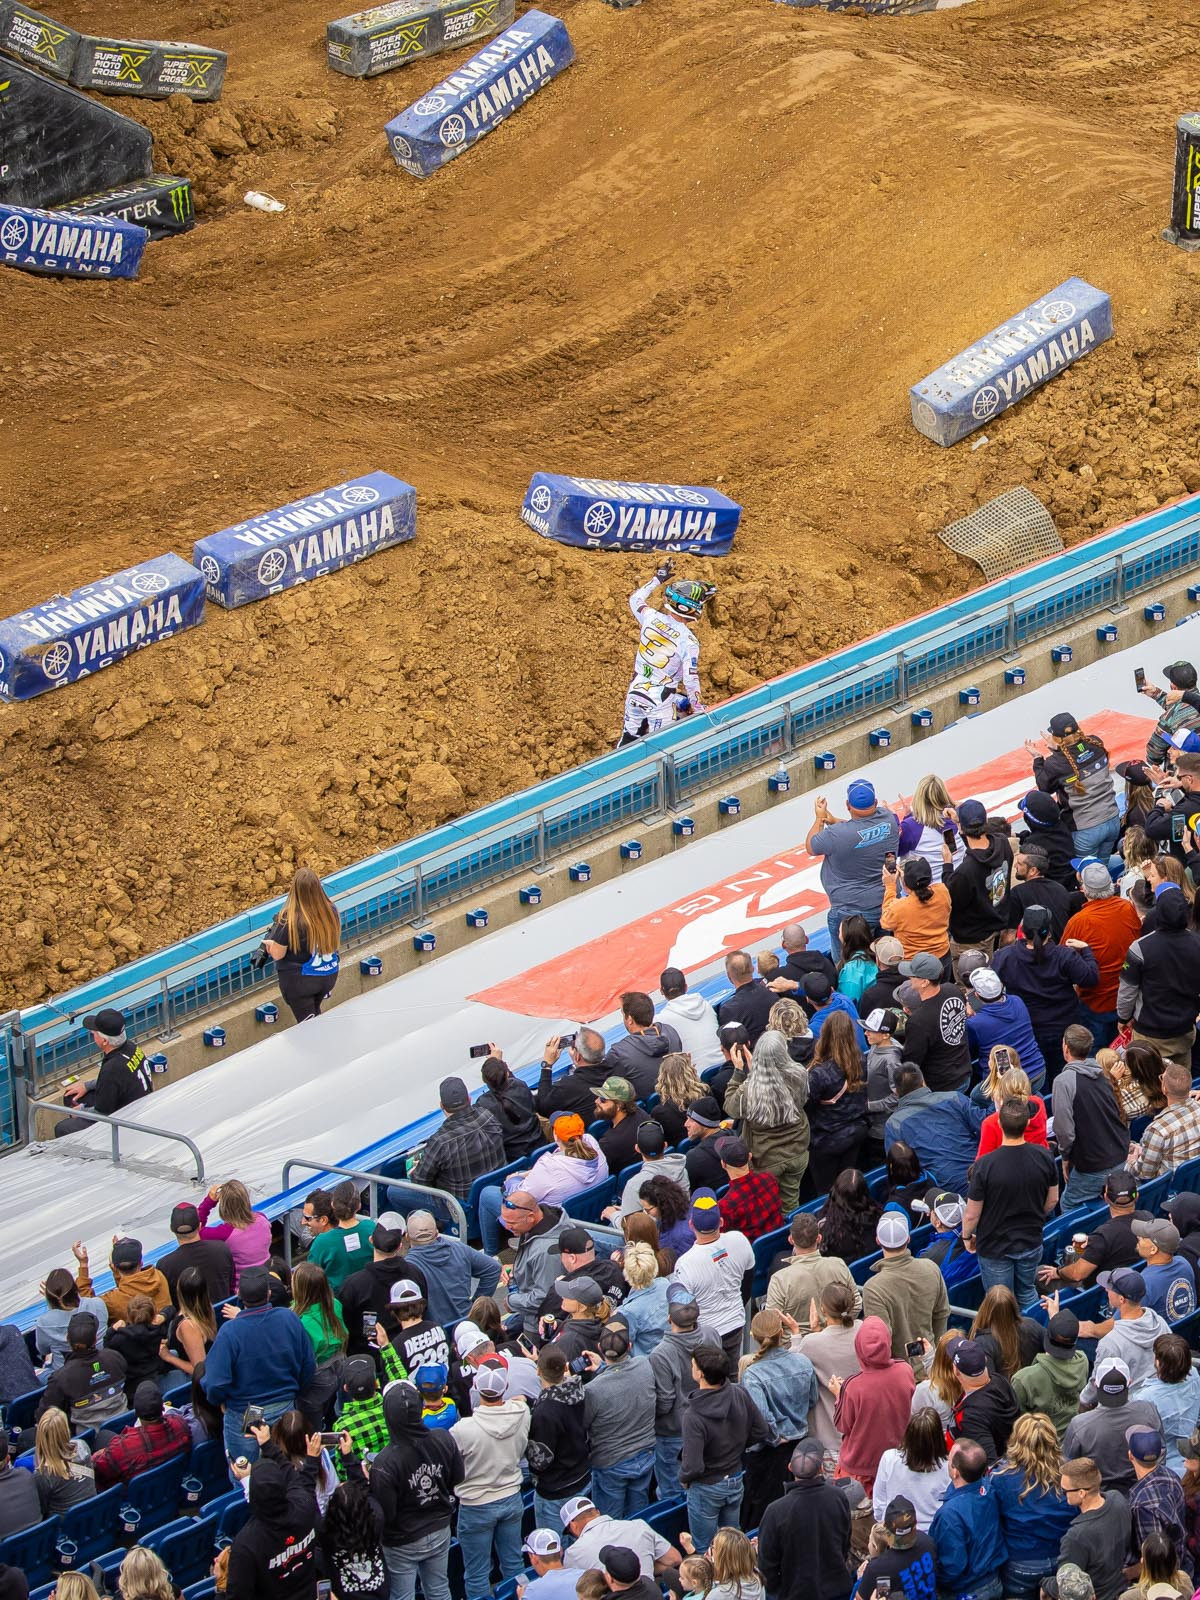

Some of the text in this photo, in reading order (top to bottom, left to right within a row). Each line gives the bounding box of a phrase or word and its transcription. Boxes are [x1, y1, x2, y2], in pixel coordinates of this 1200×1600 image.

[12, 16, 42, 35] SUPER
[444, 12, 475, 27] SUPER
[446, 19, 475, 32] MOTO
[8, 31, 38, 48] CROSS
[12, 24, 40, 42] MOTO
[370, 34, 401, 50] SUPER
[94, 52, 123, 63] SUPER
[371, 48, 401, 63] CROSS
[372, 42, 400, 56] MOTO
[92, 67, 120, 77] CROSS
[95, 61, 121, 70] MOTO
[162, 67, 188, 76] MOTO
[163, 60, 190, 70] SUPER
[435, 29, 533, 97] YAMAHA
[158, 75, 186, 84] CROSS
[462, 45, 555, 129] YAMAHA
[30, 221, 123, 264] YAMAHA
[5, 252, 112, 274] RACING
[947, 319, 1053, 387] YAMAHA
[995, 318, 1095, 401] YAMAHA
[235, 501, 358, 547] YAMAHA
[522, 506, 550, 534] YAMAHA
[616, 506, 717, 542] YAMAHA
[289, 505, 395, 573] YAMAHA
[19, 581, 143, 638] YAMAHA
[74, 594, 182, 665] YAMAHA
[651, 618, 680, 639] TOMAC
[639, 626, 679, 669] 3
[404, 1326, 446, 1358] DEEGAN
